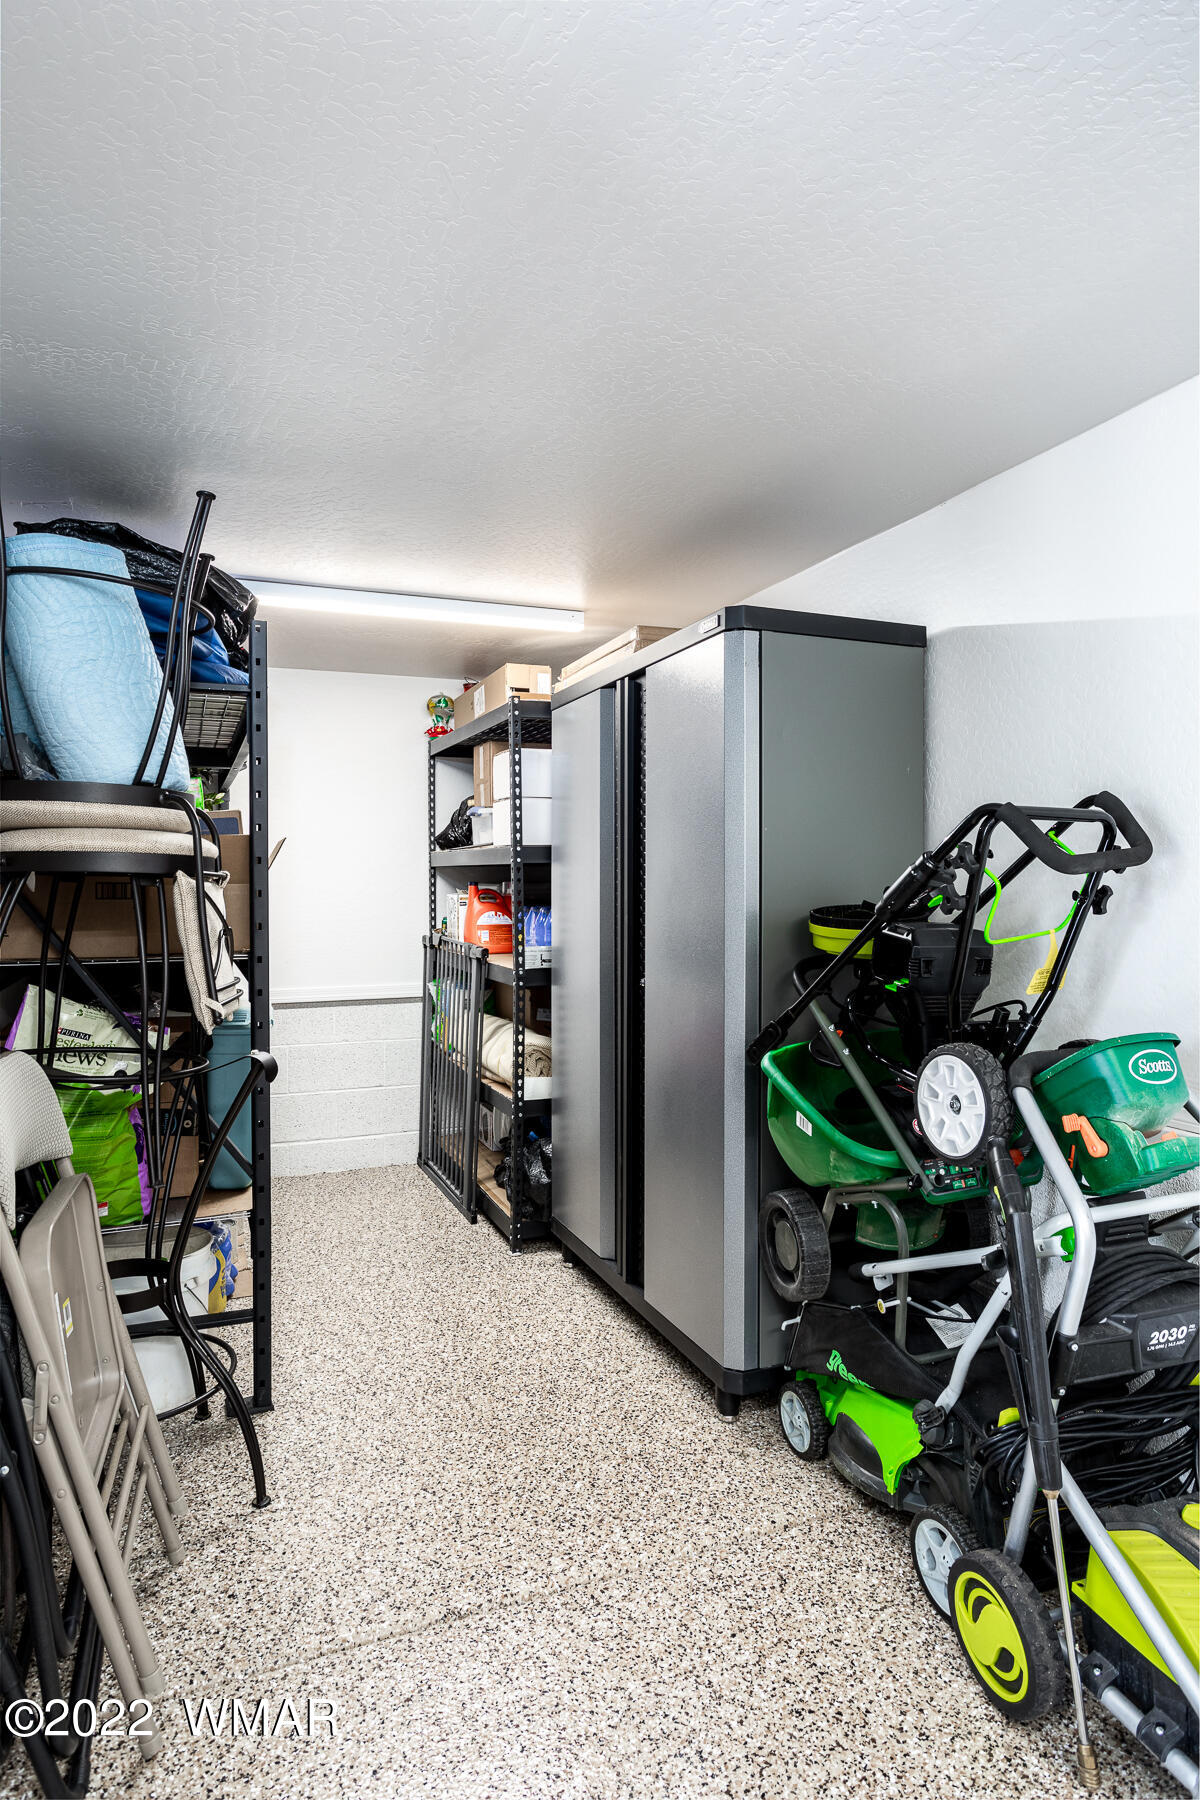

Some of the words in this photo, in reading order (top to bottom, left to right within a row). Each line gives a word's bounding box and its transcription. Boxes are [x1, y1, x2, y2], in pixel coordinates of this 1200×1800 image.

[61, 1028, 91, 1041] PURINA
[1138, 1058, 1174, 1075] Scotts
[1149, 1325, 1188, 1345] 2030
